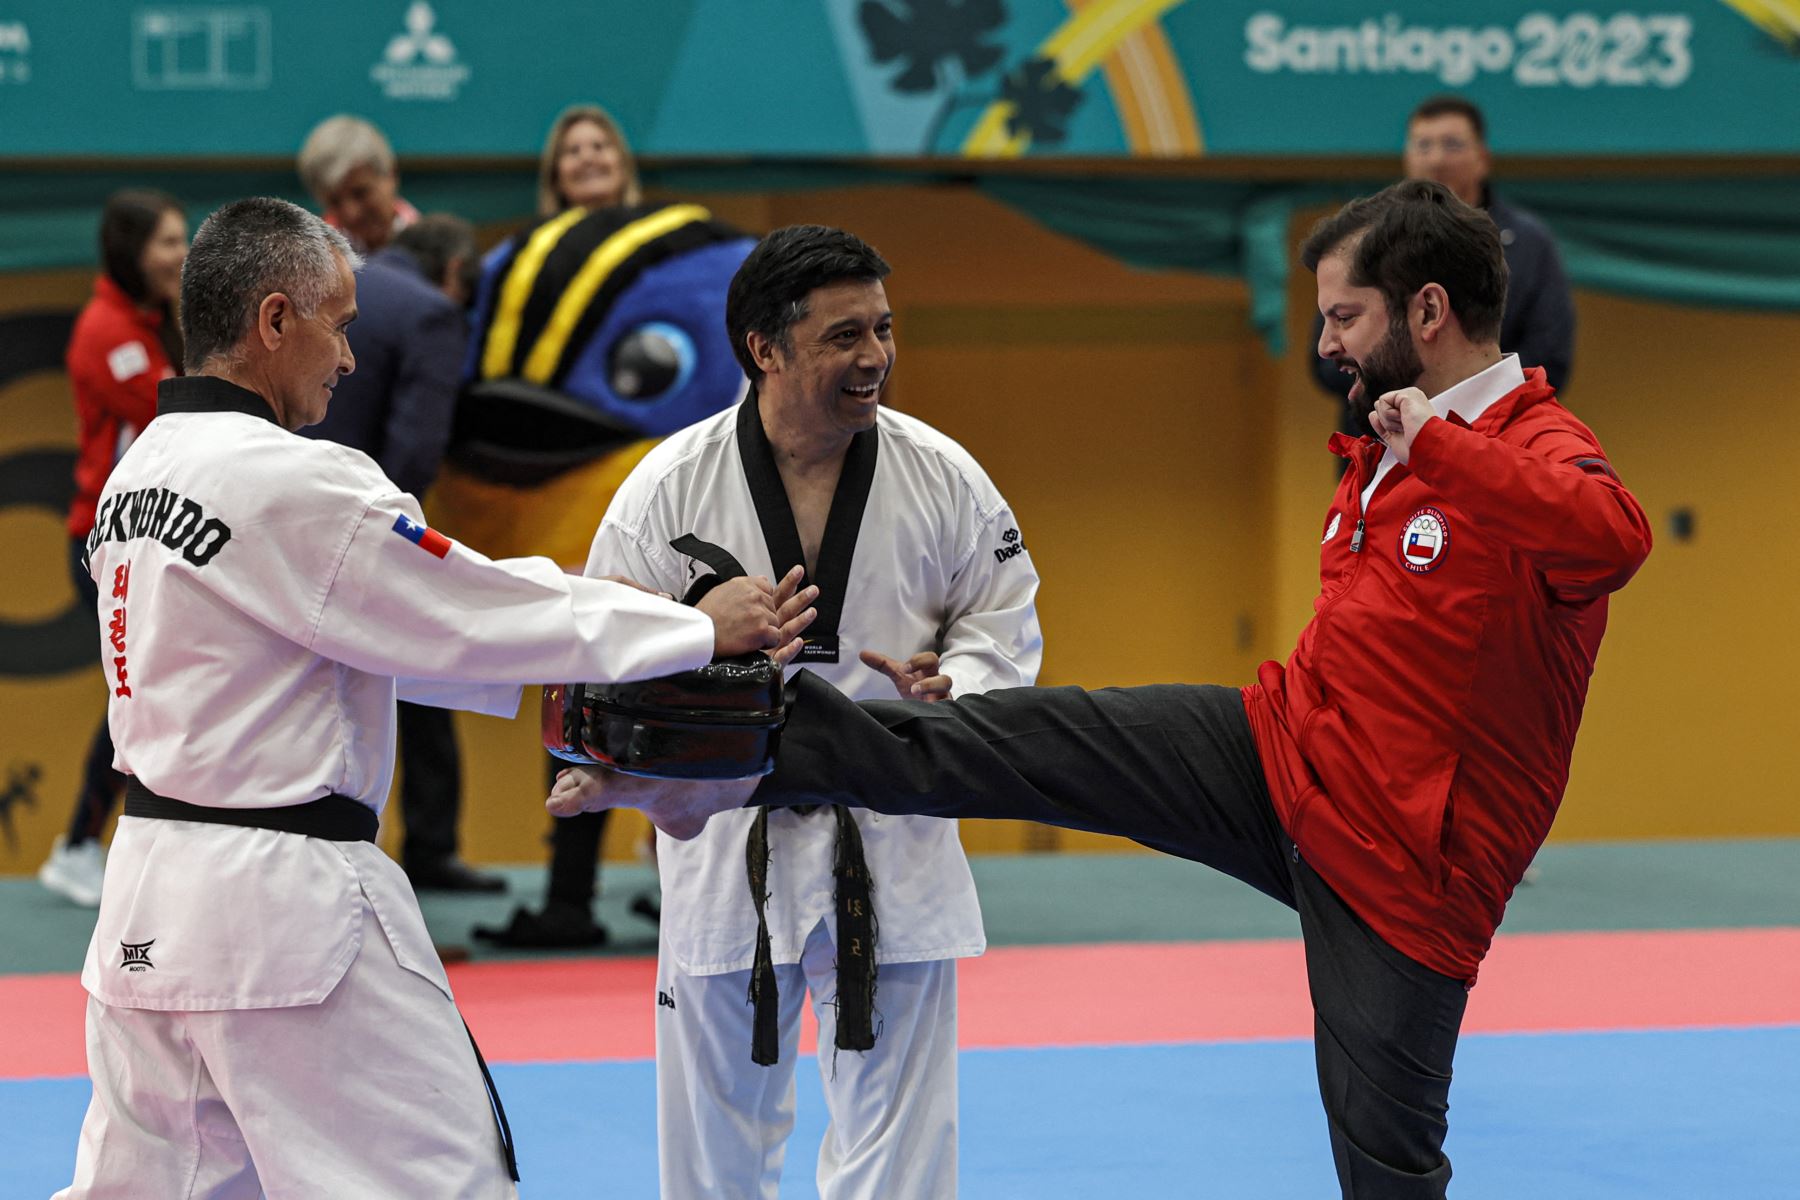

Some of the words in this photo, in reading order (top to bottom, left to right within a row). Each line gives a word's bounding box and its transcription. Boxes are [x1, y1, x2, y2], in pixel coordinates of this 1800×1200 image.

[1245, 12, 1514, 85] Santiago
[1515, 12, 1692, 87] 2023
[1405, 561, 1430, 572] CHILE
[121, 943, 152, 962] MTX
